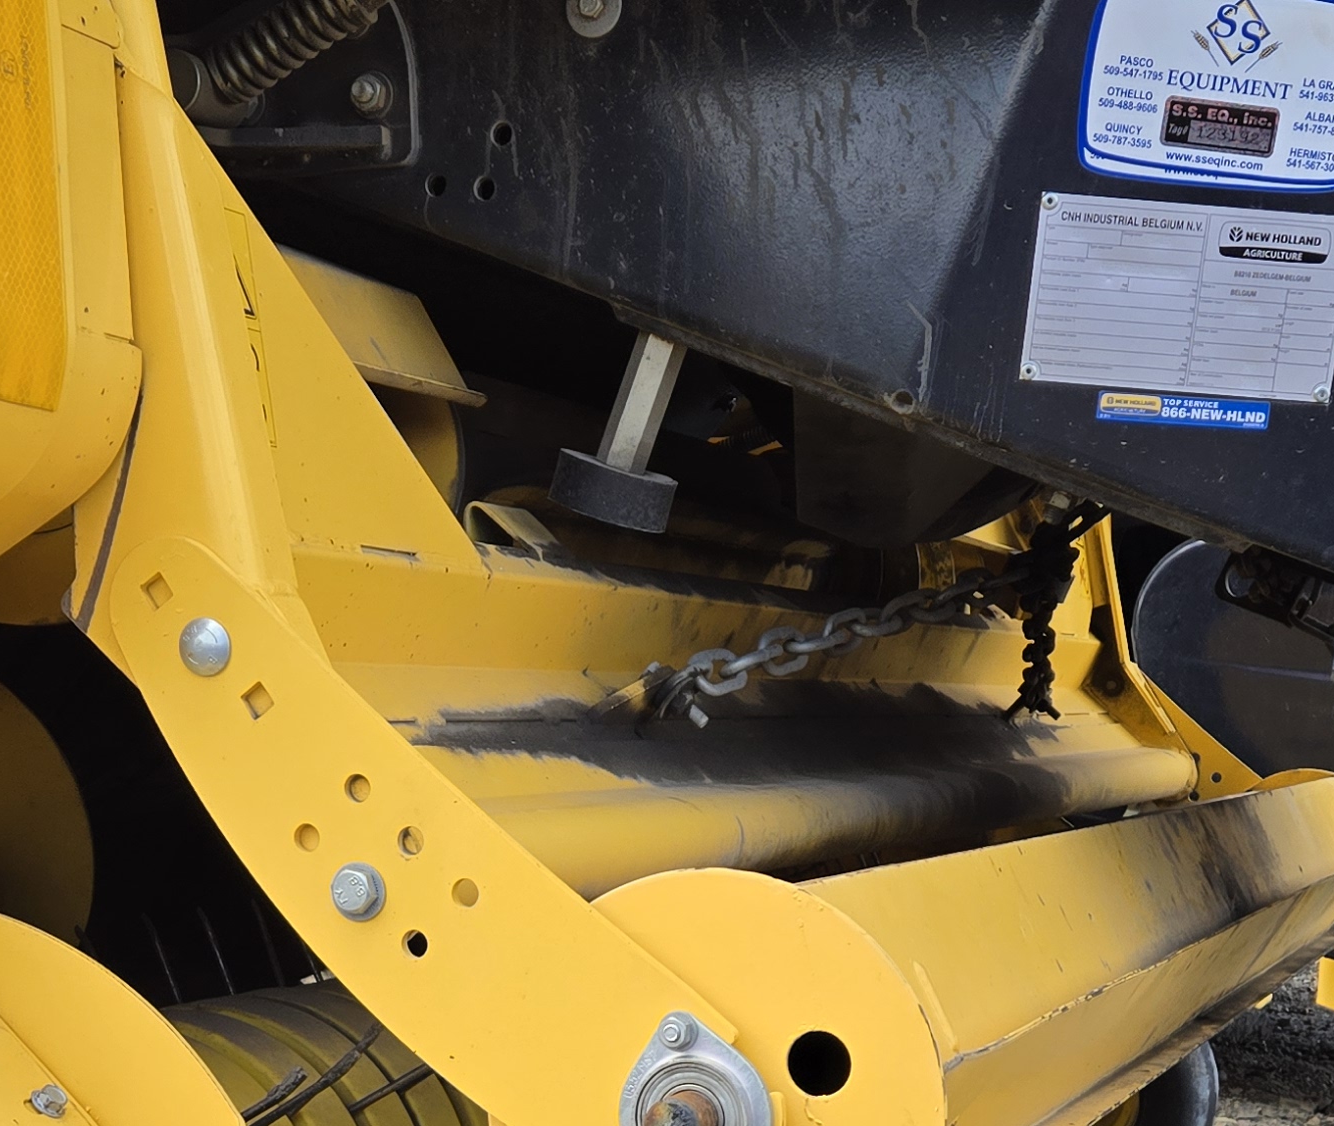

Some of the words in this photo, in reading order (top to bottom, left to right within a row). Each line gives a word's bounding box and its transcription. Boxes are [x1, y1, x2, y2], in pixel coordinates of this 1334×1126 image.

[1119, 55, 1154, 68] PASCO
[1103, 65, 1164, 81] 509-547-1795
[1167, 69, 1293, 100] EQUIPMENT
[1303, 78, 1316, 89] LA
[1107, 86, 1153, 101] OTHELLO
[1098, 98, 1158, 113] 509-488-9606
[1172, 103, 1202, 119] S.S.
[1105, 122, 1143, 135] QUINCY
[1093, 133, 1152, 149] 509-787-3595
[1166, 151, 1263, 171] www.sseqinc.com
[1061, 211, 1082, 223] CNH
[1083, 213, 1139, 228] INDUSTRIAL
[1142, 217, 1184, 230] BELGIUM
[1186, 220, 1203, 232] N.V.
[1245, 231, 1270, 243] NEW
[1272, 233, 1322, 247] HOLLAND
[1242, 248, 1303, 262] AGRICULTURE
[1230, 289, 1257, 297] BELGIUM
[1163, 398, 1182, 406] TOP
[1183, 400, 1219, 408] SERVICE
[1161, 407, 1266, 423] 866-NEW-HLND
